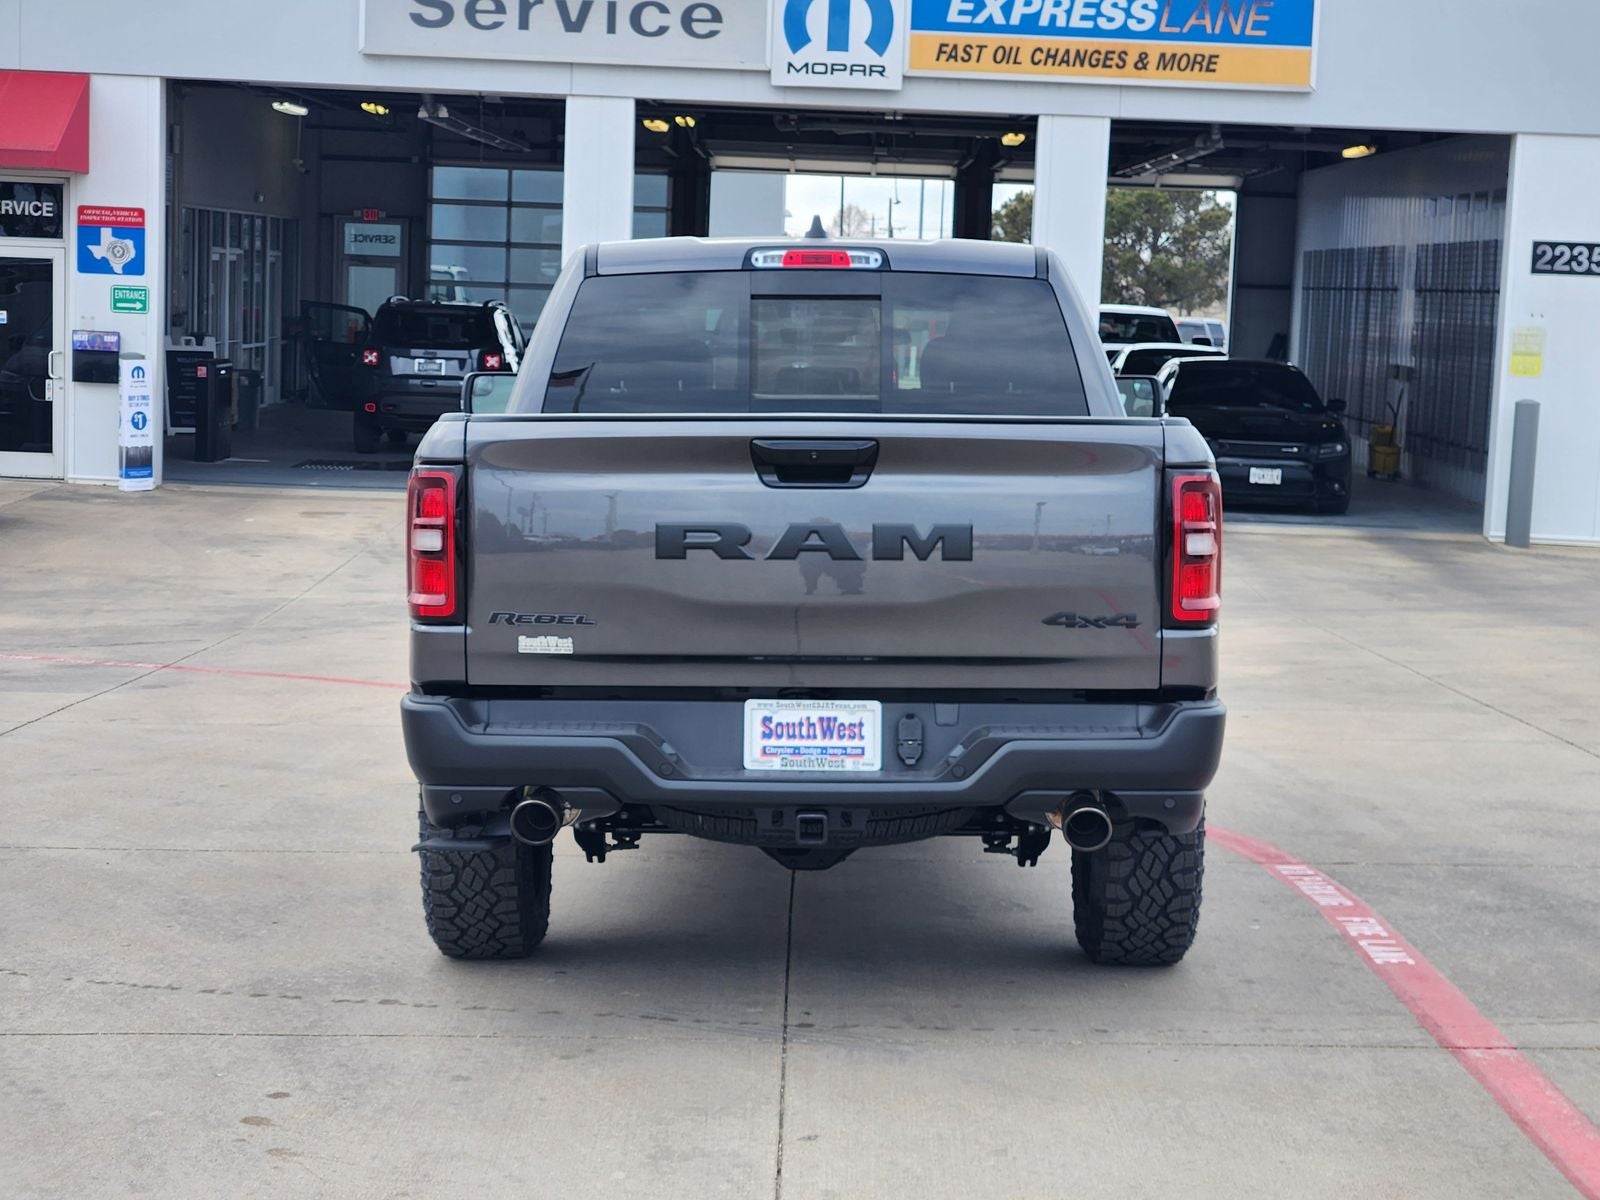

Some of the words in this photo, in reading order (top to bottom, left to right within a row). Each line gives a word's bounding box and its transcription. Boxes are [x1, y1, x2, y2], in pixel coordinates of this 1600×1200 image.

[409, 0, 724, 39] Service
[935, 43, 987, 65] FAST
[992, 47, 1024, 66] OIL
[1030, 47, 1127, 70] CHANGES
[1133, 51, 1151, 70] &
[1156, 52, 1220, 74] MORE
[787, 61, 887, 77] MOPAR
[0, 199, 54, 217] RVICE
[1535, 243, 1600, 273] 2235
[114, 289, 146, 300] ENTRANCE
[655, 522, 974, 562] RAM
[488, 611, 596, 626] REBEL
[1040, 610, 1142, 629] 4x4
[760, 714, 866, 741] SouthWest
[765, 746, 795, 755] Chrysler
[799, 747, 822, 756] Dodge
[826, 747, 843, 756] Jeep
[846, 747, 863, 755] Ram
[780, 757, 846, 769] SouthWest
